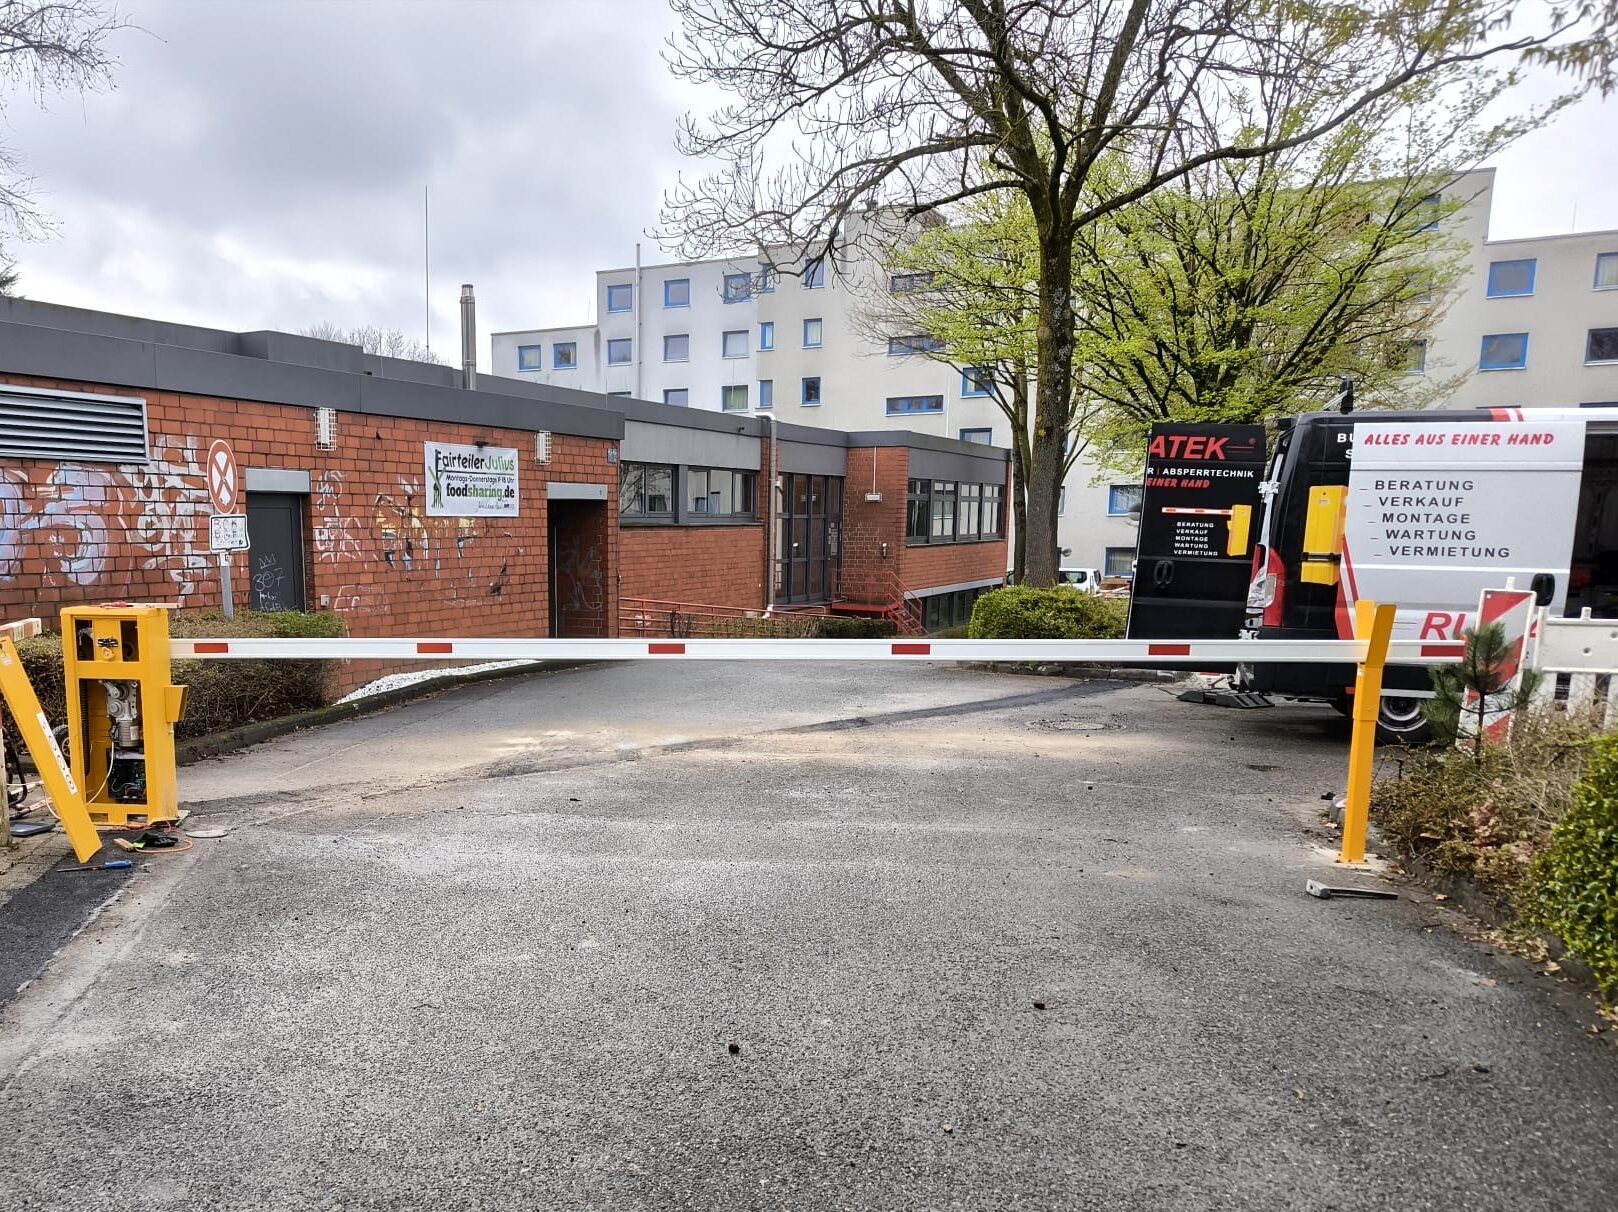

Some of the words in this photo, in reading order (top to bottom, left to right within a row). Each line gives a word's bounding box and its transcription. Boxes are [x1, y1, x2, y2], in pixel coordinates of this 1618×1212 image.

[1364, 433, 1411, 446] ALLES
[1415, 433, 1446, 446] AUS
[1451, 433, 1502, 446] EINER
[1507, 433, 1554, 445] HAND
[1162, 467, 1255, 478] ABSPERRTECHNIK
[1147, 478, 1177, 488] EINER
[1180, 478, 1210, 488] HAND
[1374, 480, 1474, 491] BERATUNG
[446, 482, 515, 501] foodsharing.de
[1379, 496, 1464, 507] VERKAUF
[1382, 513, 1471, 524] MONTAGE
[1385, 529, 1476, 541] WARTUNG
[1389, 546, 1510, 558] VERMIETUNG
